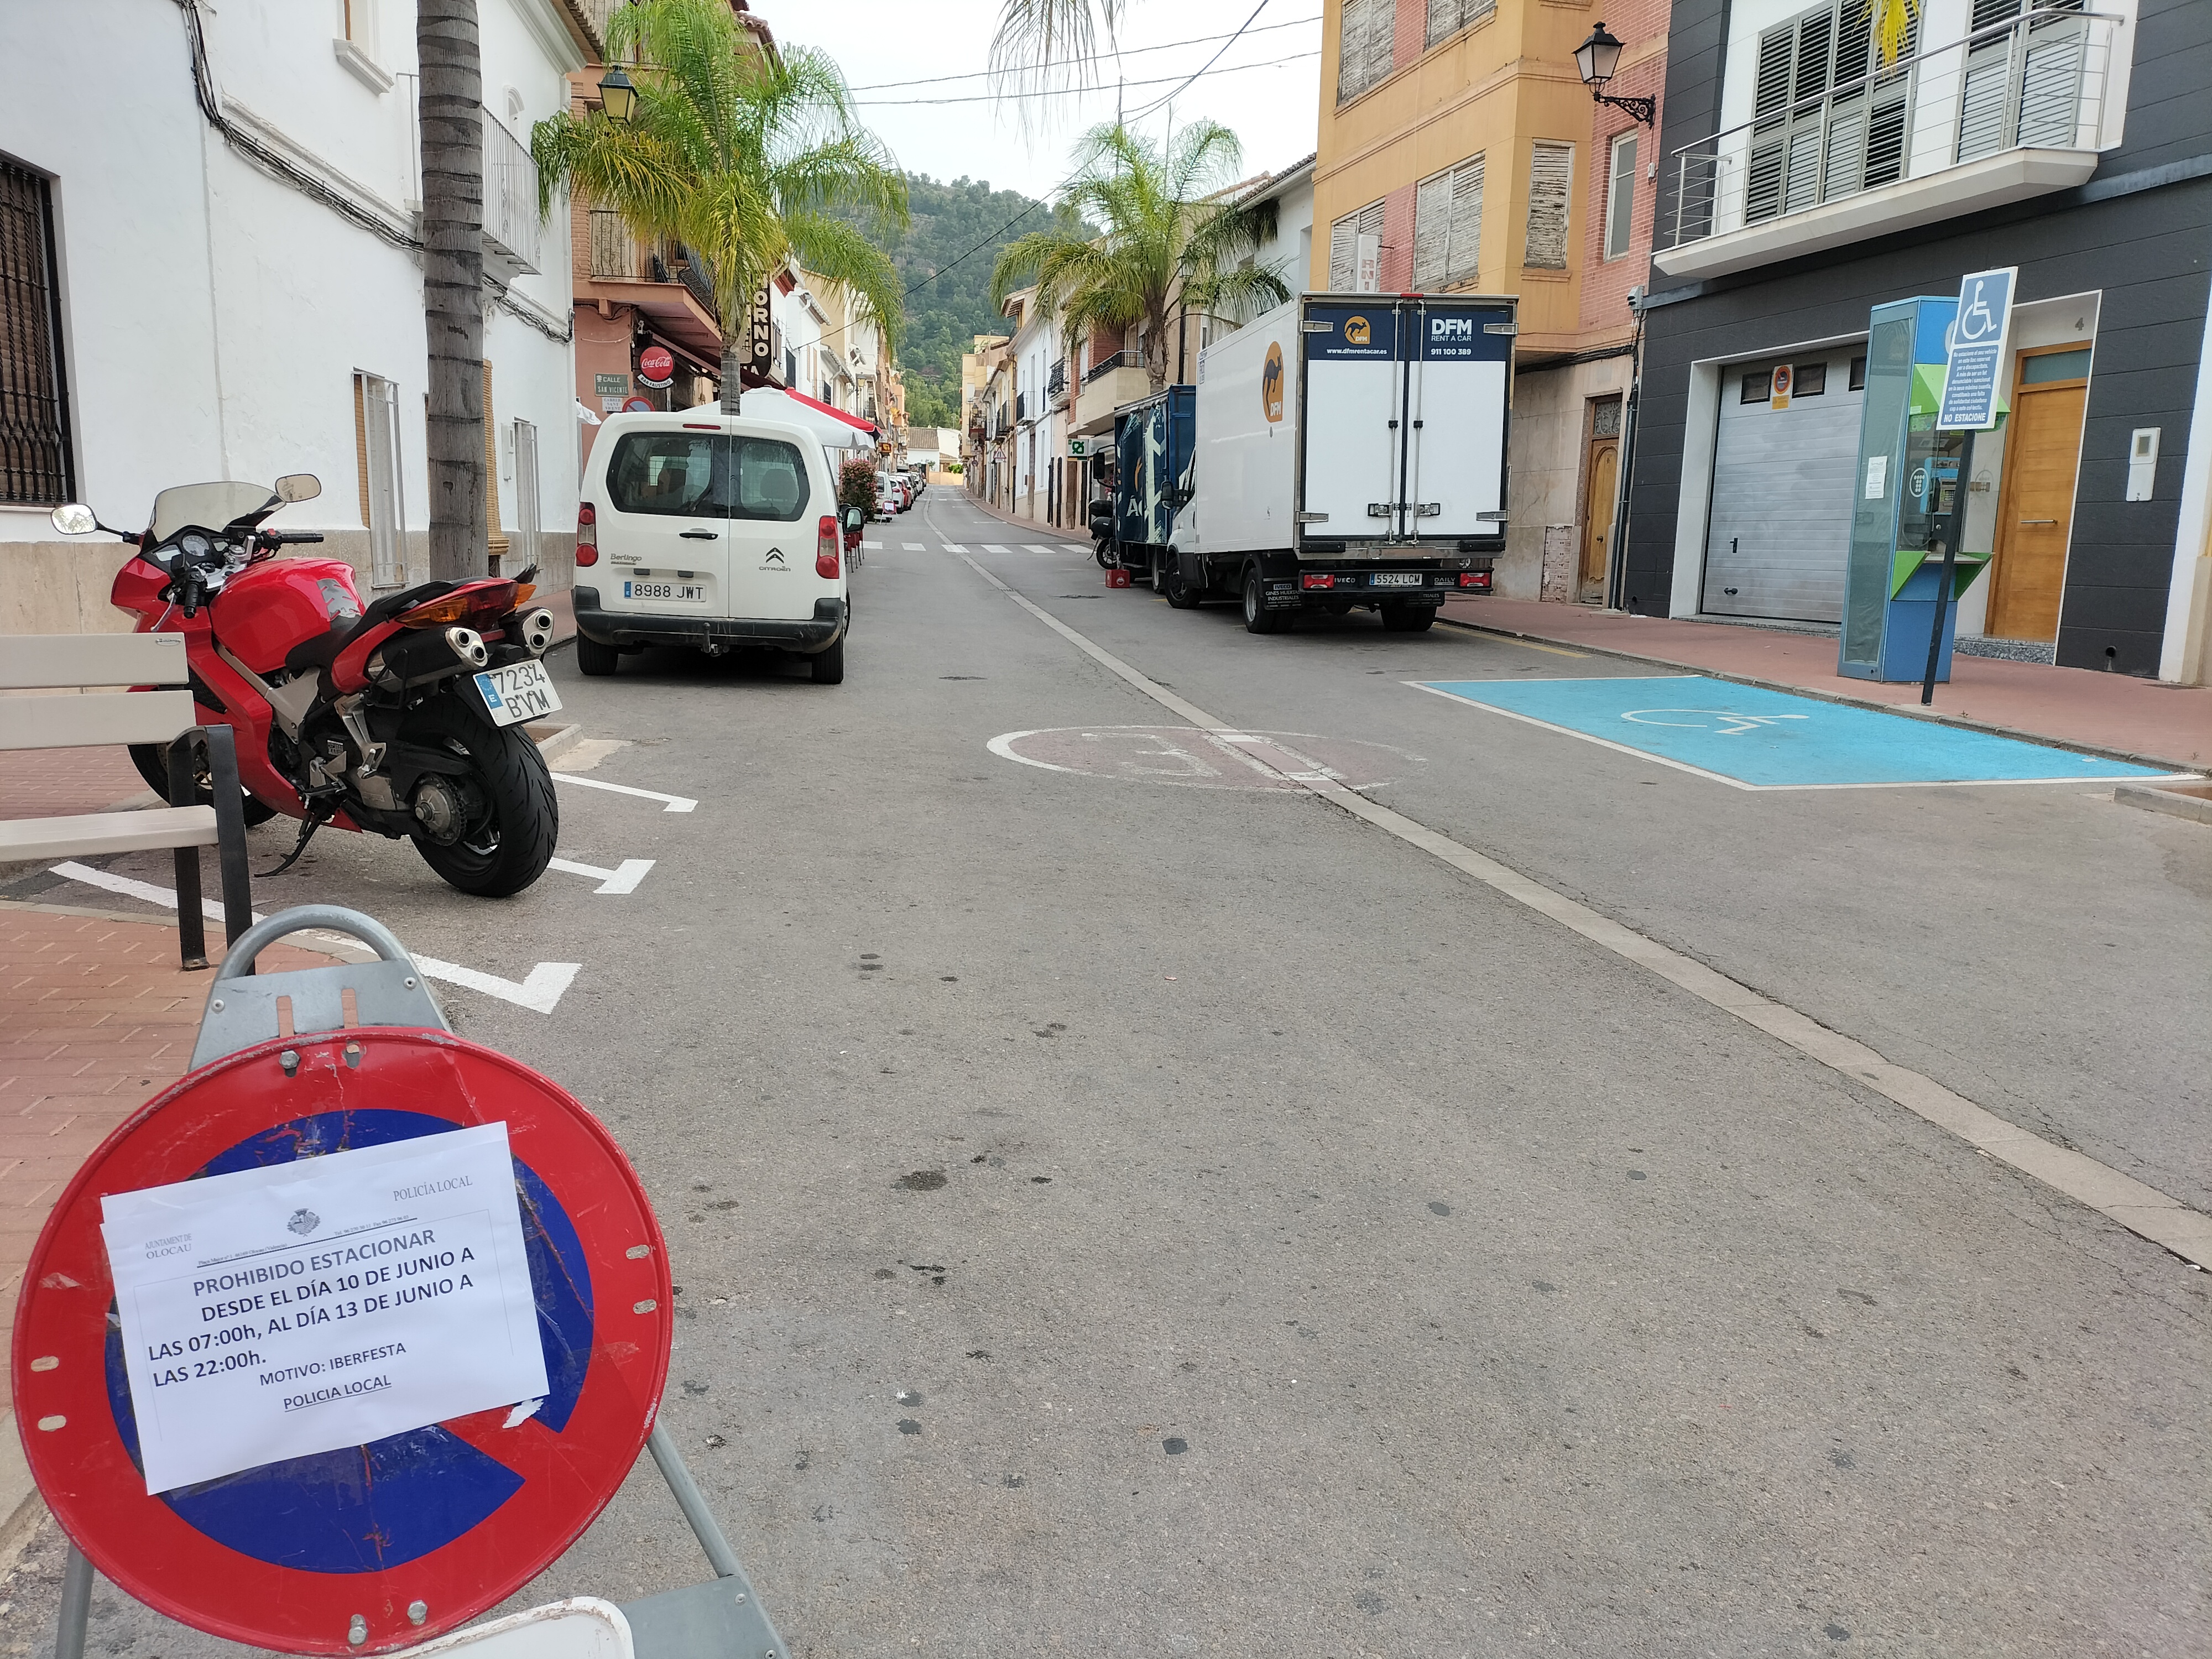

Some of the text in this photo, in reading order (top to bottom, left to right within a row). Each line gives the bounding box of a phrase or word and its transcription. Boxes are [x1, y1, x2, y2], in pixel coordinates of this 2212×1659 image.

[1432, 319, 1472, 335] DFM
[2075, 317, 2084, 331] 4
[640, 377, 671, 388] BAR FAUSTINO
[1270, 401, 1281, 416] DFM
[1944, 413, 1986, 422] NO ESTACIONE
[611, 554, 642, 562] Berlingo
[1376, 575, 1399, 583] 5524
[635, 584, 671, 597] 8988
[676, 586, 703, 599] JWT
[490, 664, 545, 693] 7234
[505, 689, 550, 718] BVM
[393, 1176, 472, 1201] POLICÍA LOCAL
[145, 1233, 192, 1250] AJUNTAMENT DE
[146, 1244, 192, 1259] OLOCAU
[194, 1230, 435, 1296] PROHIBIDO ESTACIONAR
[202, 1247, 475, 1322] DESDE EL DÍA 10 DE JUNIO A
[149, 1274, 473, 1361] LAS 07:00h, AL DÍA 13 DE JUNIO A
[153, 1350, 267, 1387] LAS 22:00h.
[260, 1343, 406, 1386] MOTIVO: IBERFESTA
[284, 1375, 392, 1409] POLICIA LOCAL
